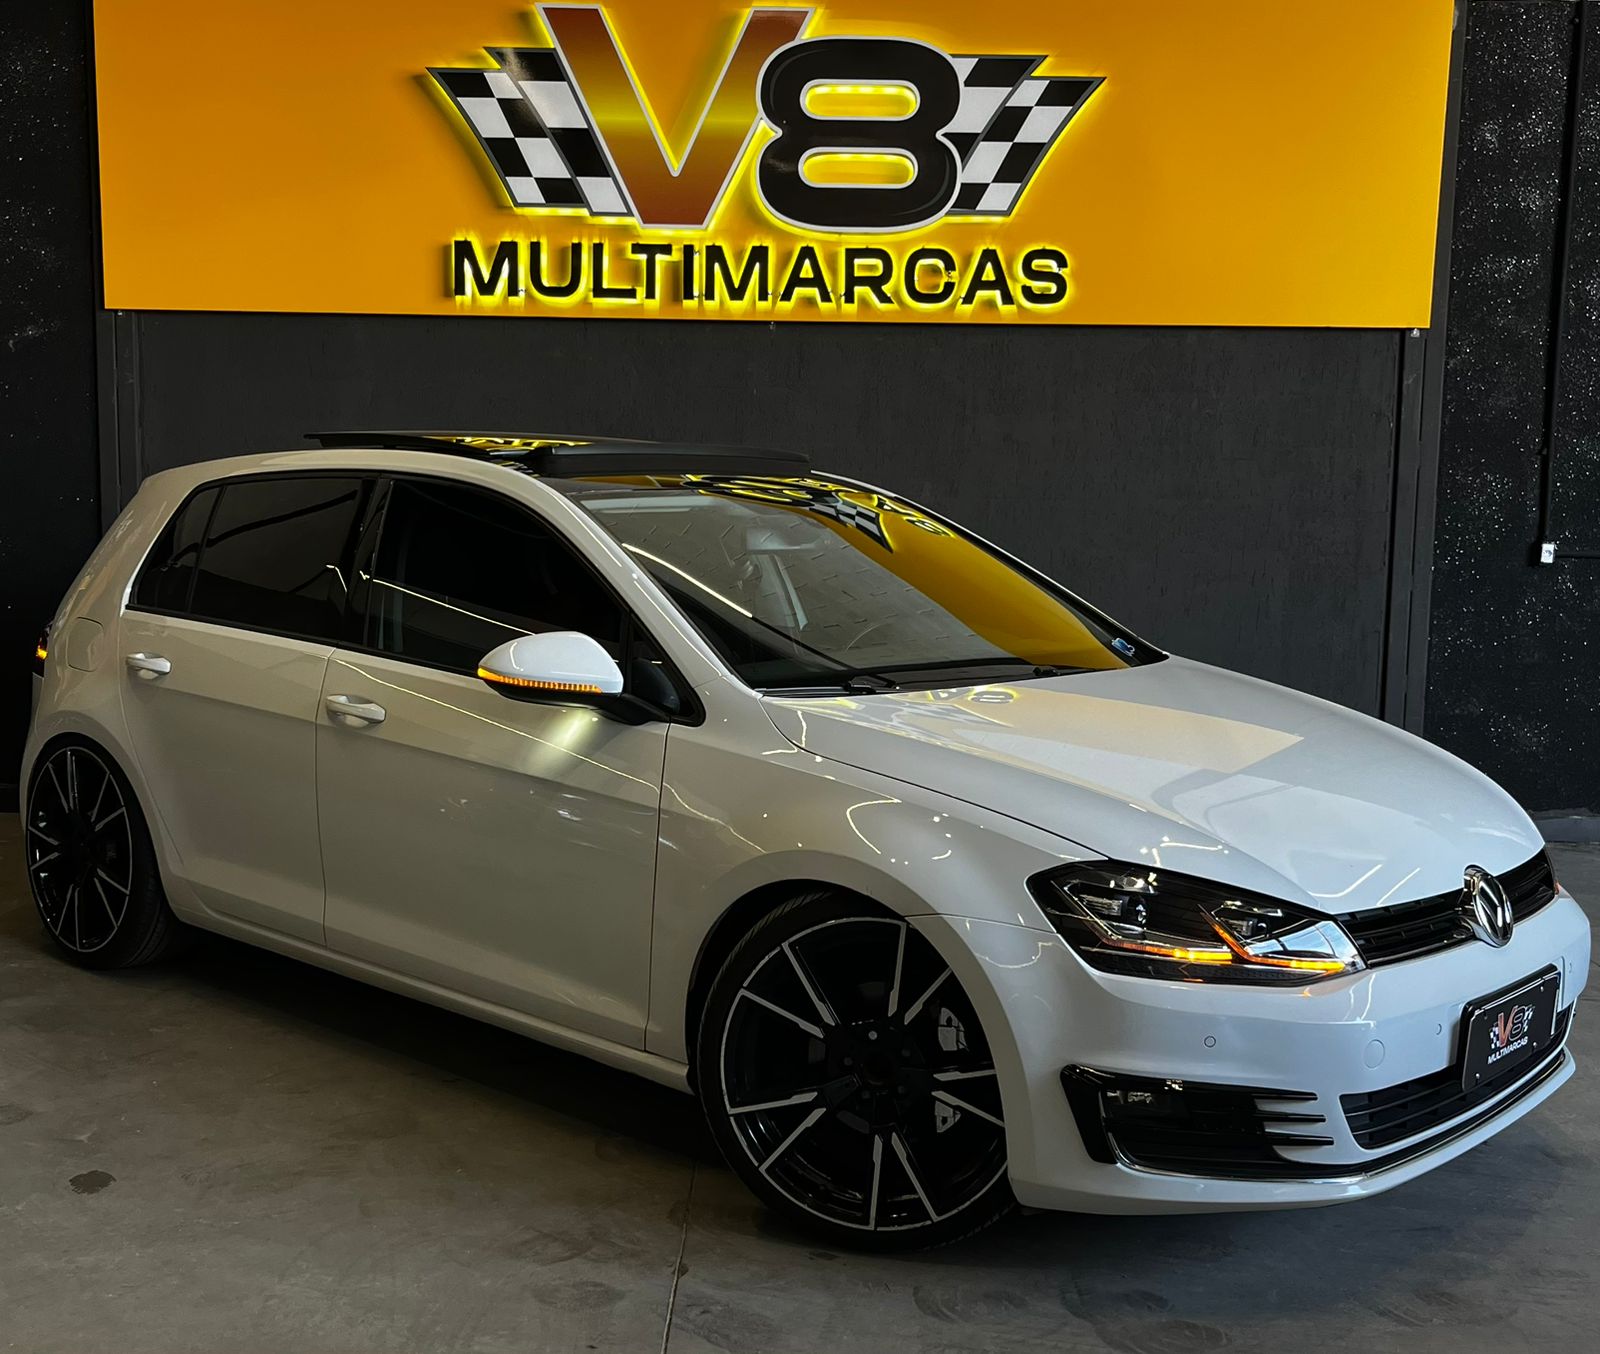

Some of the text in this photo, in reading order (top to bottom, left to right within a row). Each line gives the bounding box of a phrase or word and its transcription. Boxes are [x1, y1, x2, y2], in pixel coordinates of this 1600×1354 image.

[535, 4, 961, 230] V8
[452, 239, 1069, 304] MULTIMARCAS
[1487, 1036, 1529, 1065] MULTIMARCAS
[1497, 1005, 1527, 1048] V8
